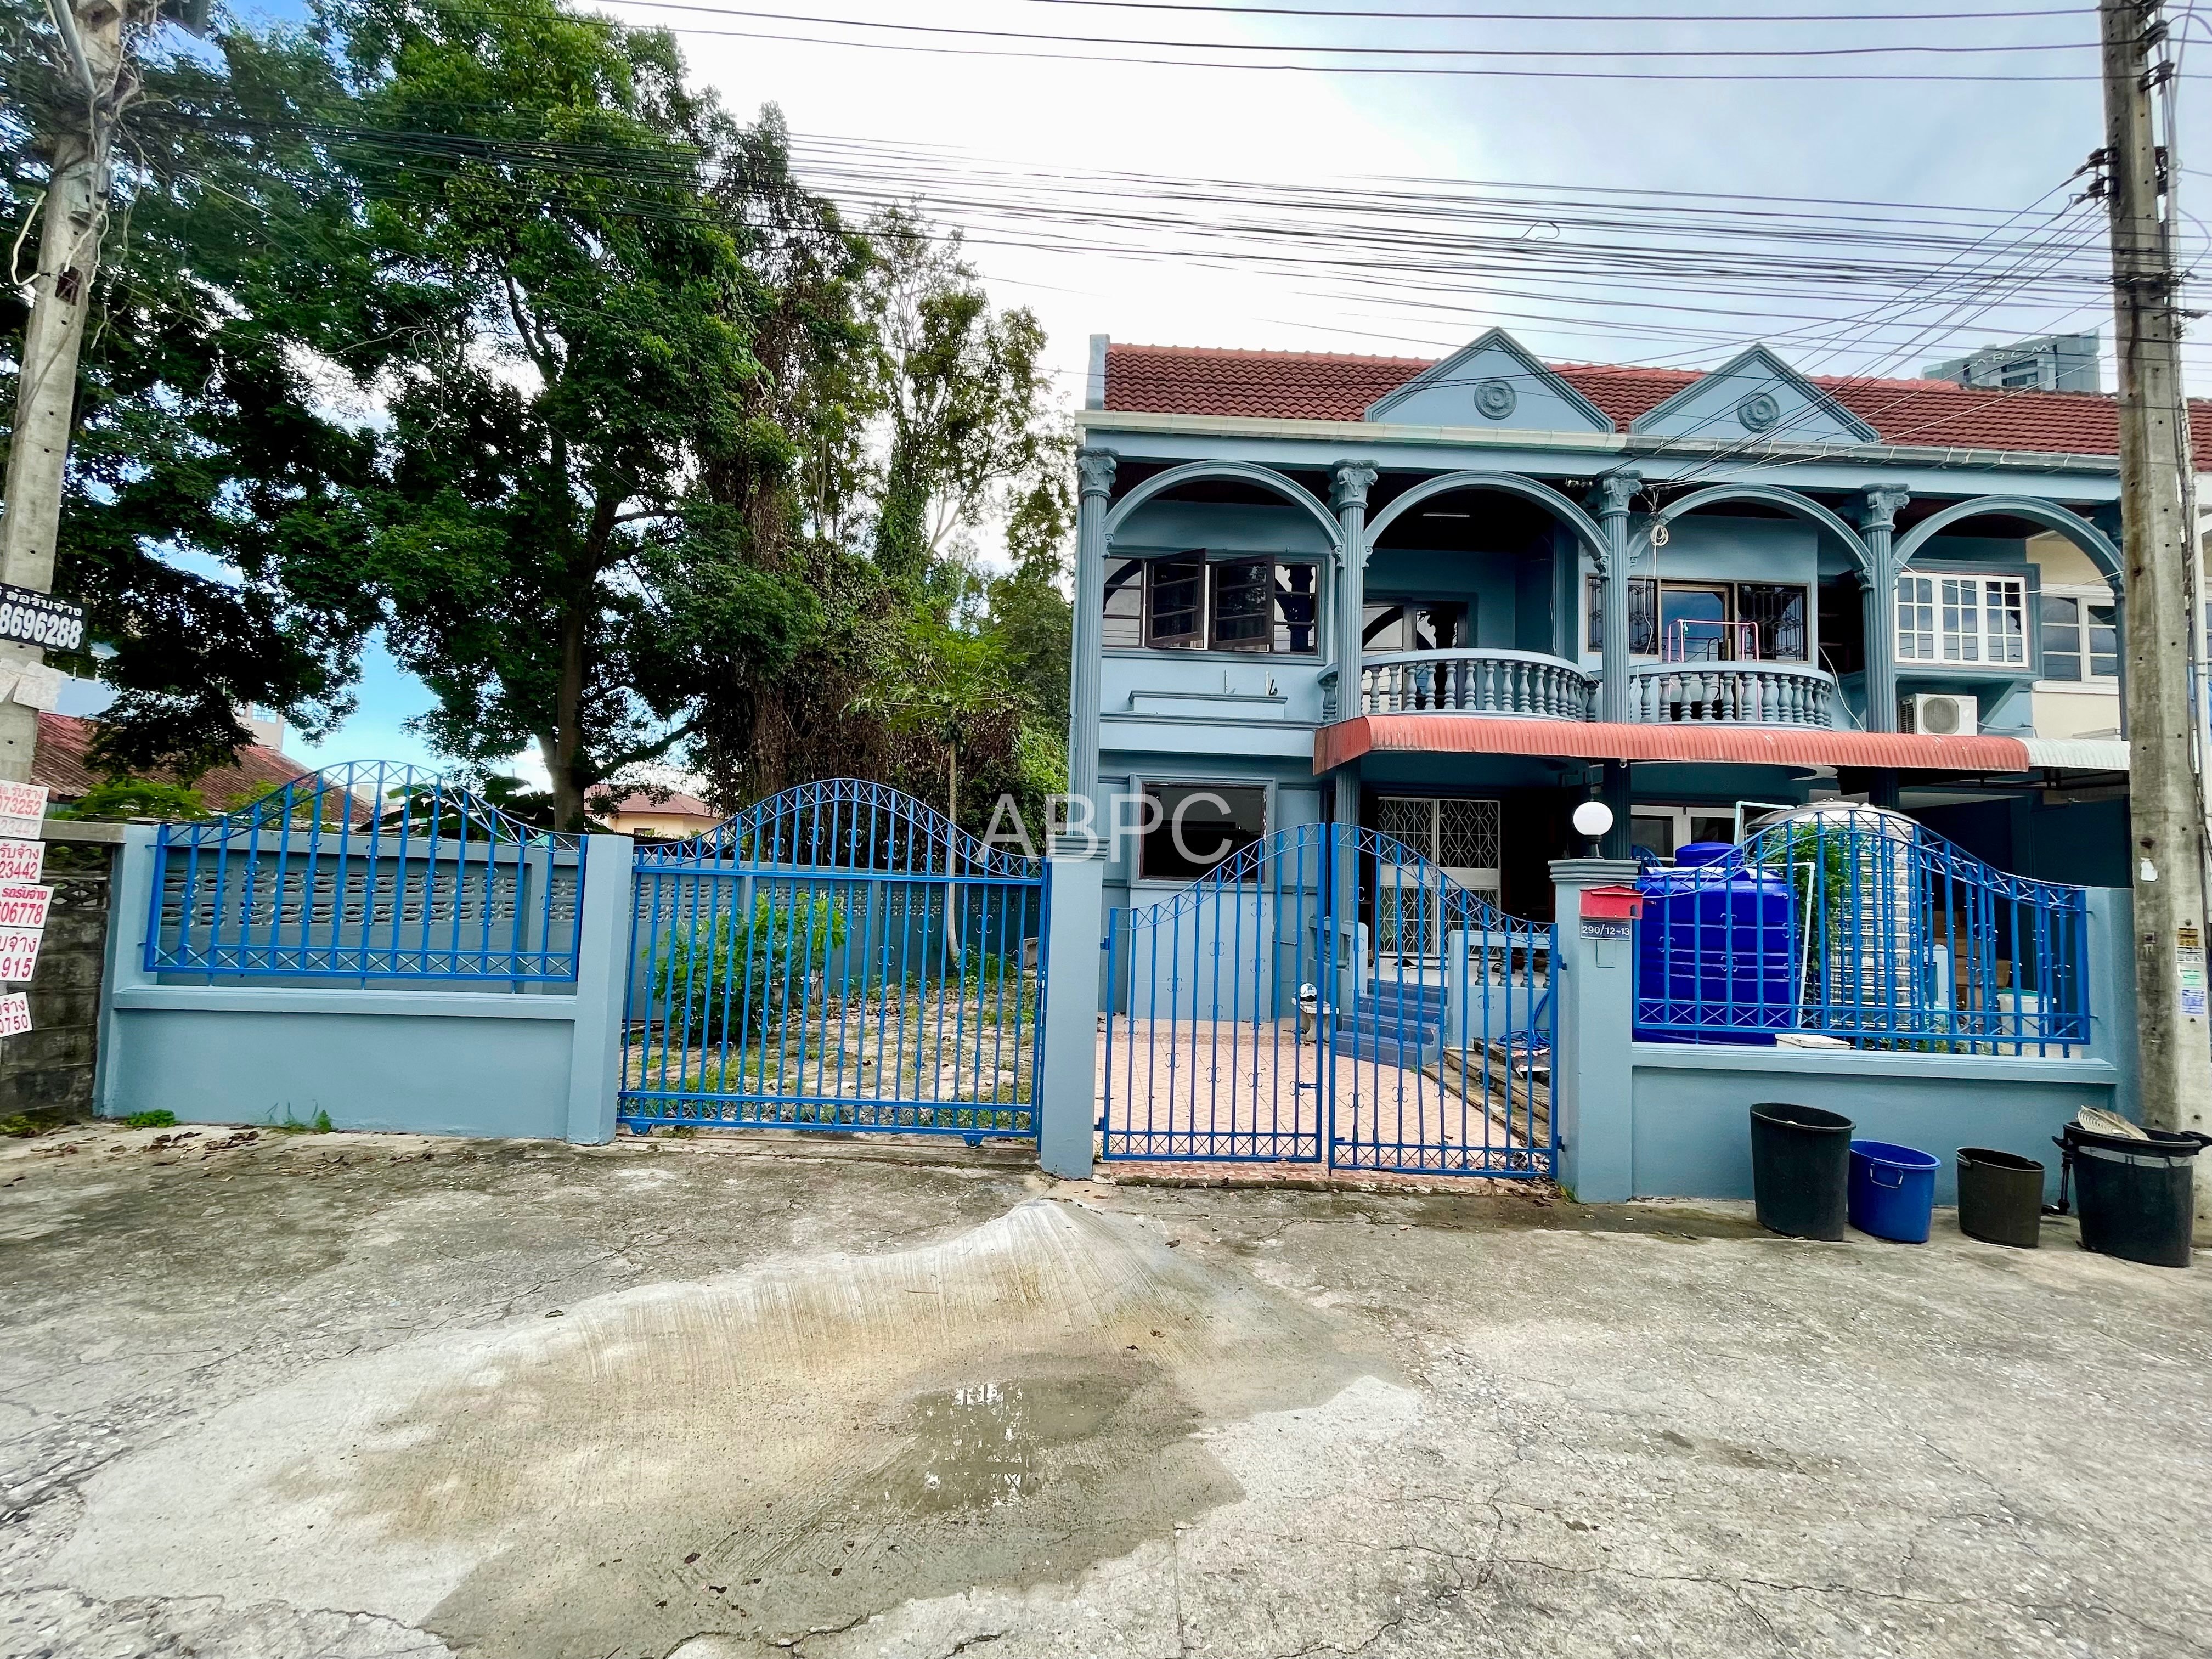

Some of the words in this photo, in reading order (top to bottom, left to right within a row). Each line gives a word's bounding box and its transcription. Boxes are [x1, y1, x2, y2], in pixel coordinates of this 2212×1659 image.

[0, 603, 83, 649] 8696288
[0, 843, 40, 859] รับจ้าง
[0, 861, 37, 879] 23442
[0, 900, 43, 924] 06778
[1582, 924, 1630, 936] 290/12-13
[1, 957, 32, 978] 915
